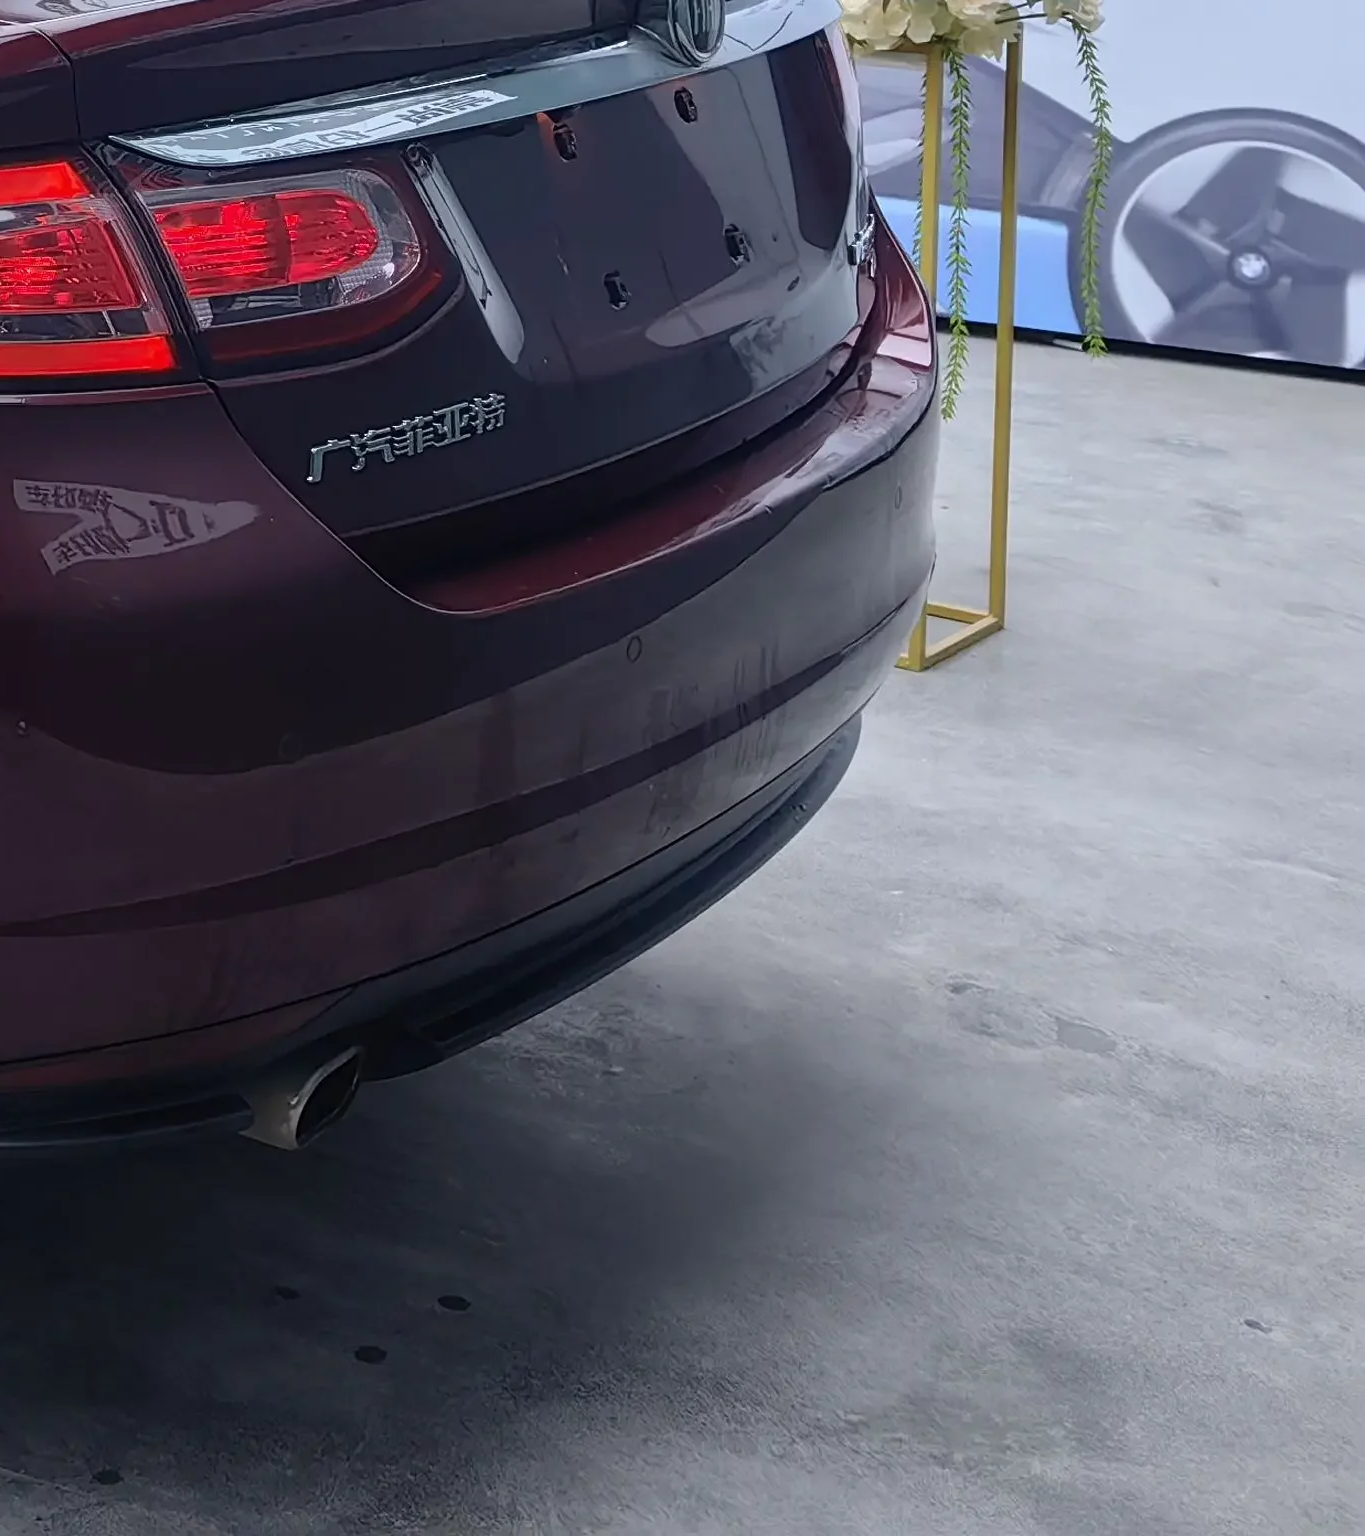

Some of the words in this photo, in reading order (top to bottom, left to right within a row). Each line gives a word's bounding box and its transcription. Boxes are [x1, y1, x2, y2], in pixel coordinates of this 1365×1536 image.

[305, 392, 506, 483] 广汽菲亚特
